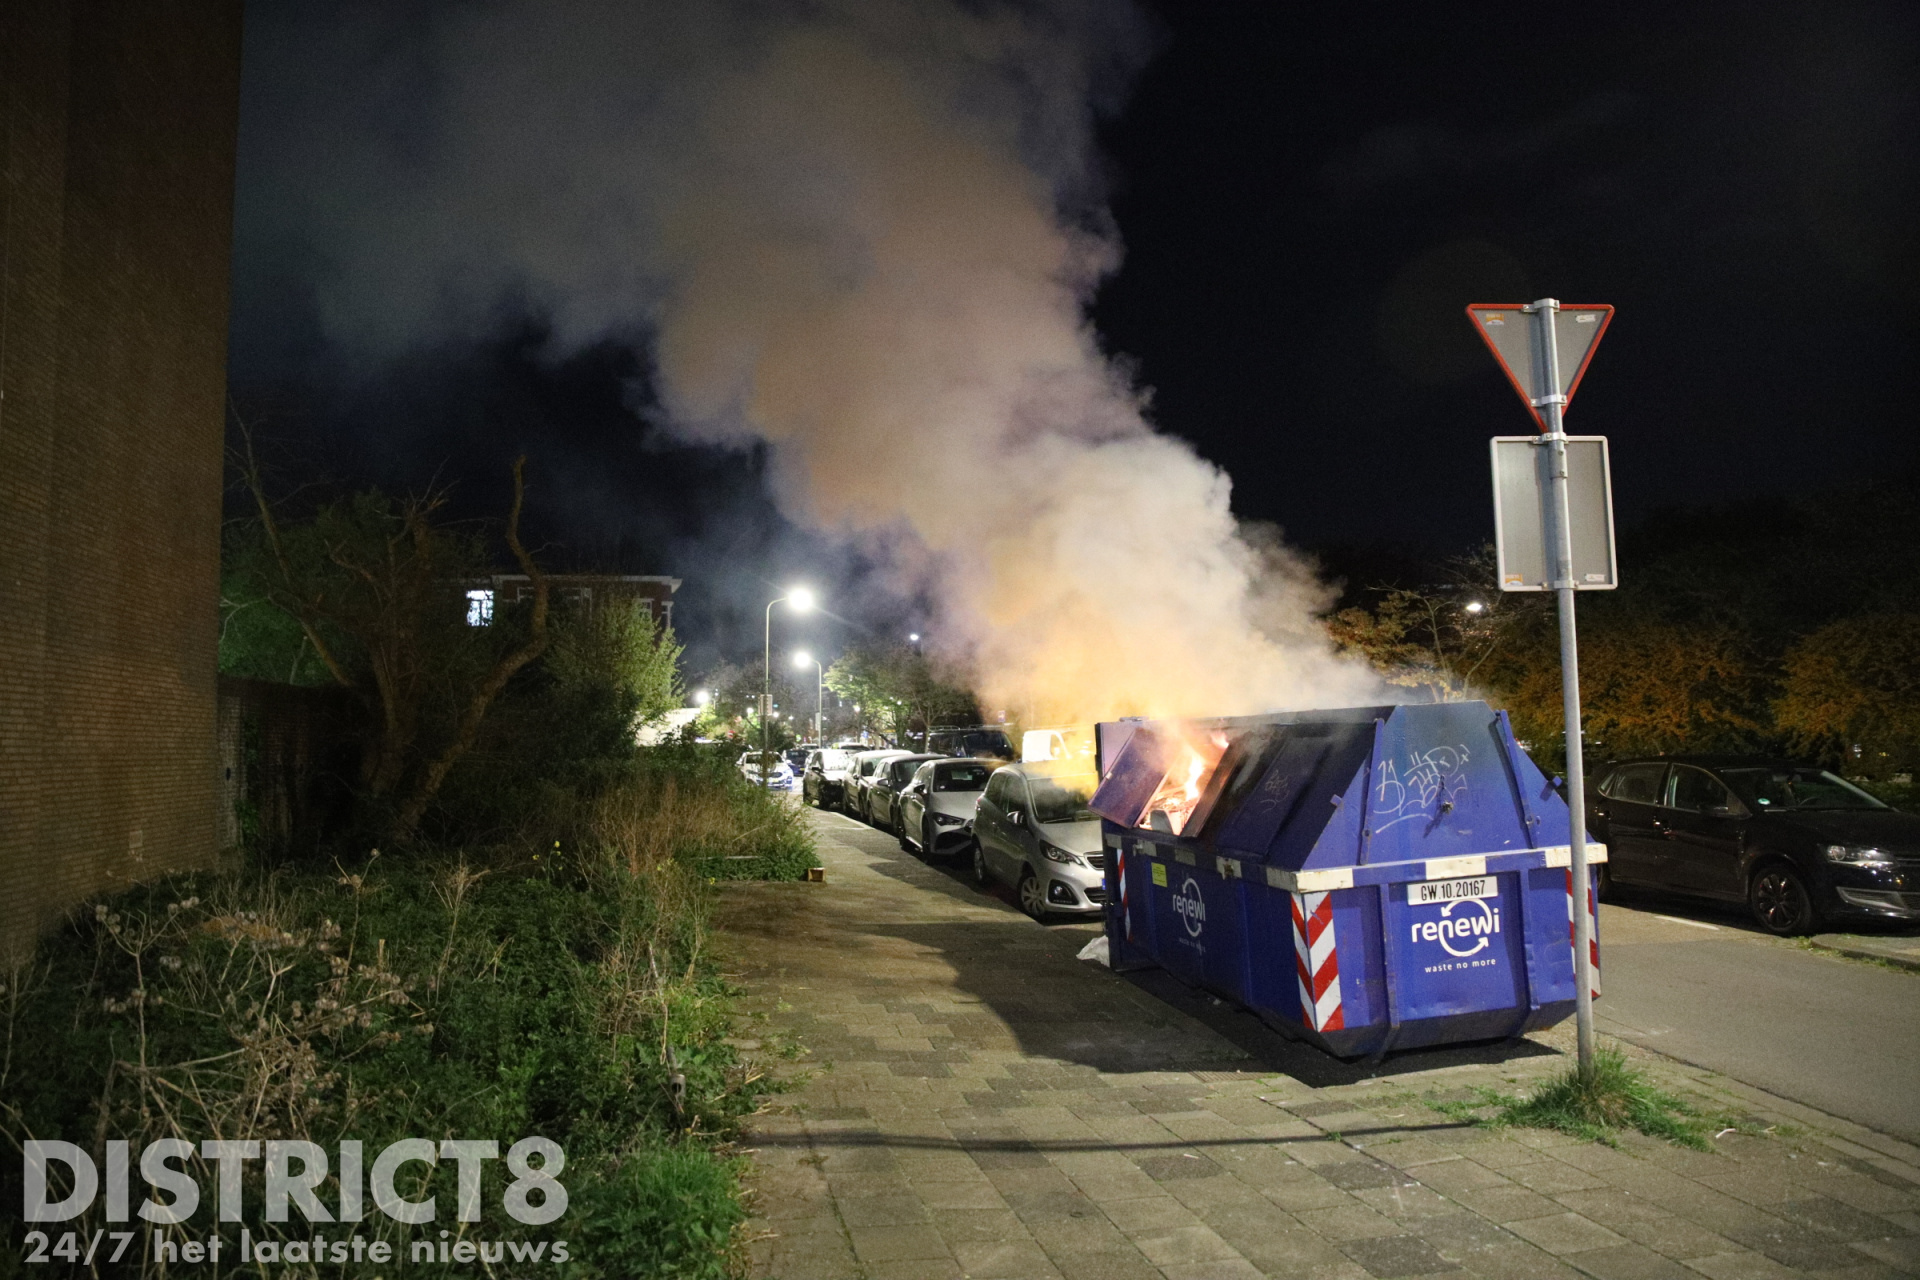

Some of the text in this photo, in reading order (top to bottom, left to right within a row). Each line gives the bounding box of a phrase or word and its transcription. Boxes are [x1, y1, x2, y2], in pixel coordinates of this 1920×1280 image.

[1420, 879, 1486, 902] GW.10.20167
[1172, 893, 1206, 922] renewi
[1411, 907, 1500, 943] renewi
[1424, 957, 1496, 973] waste no more
